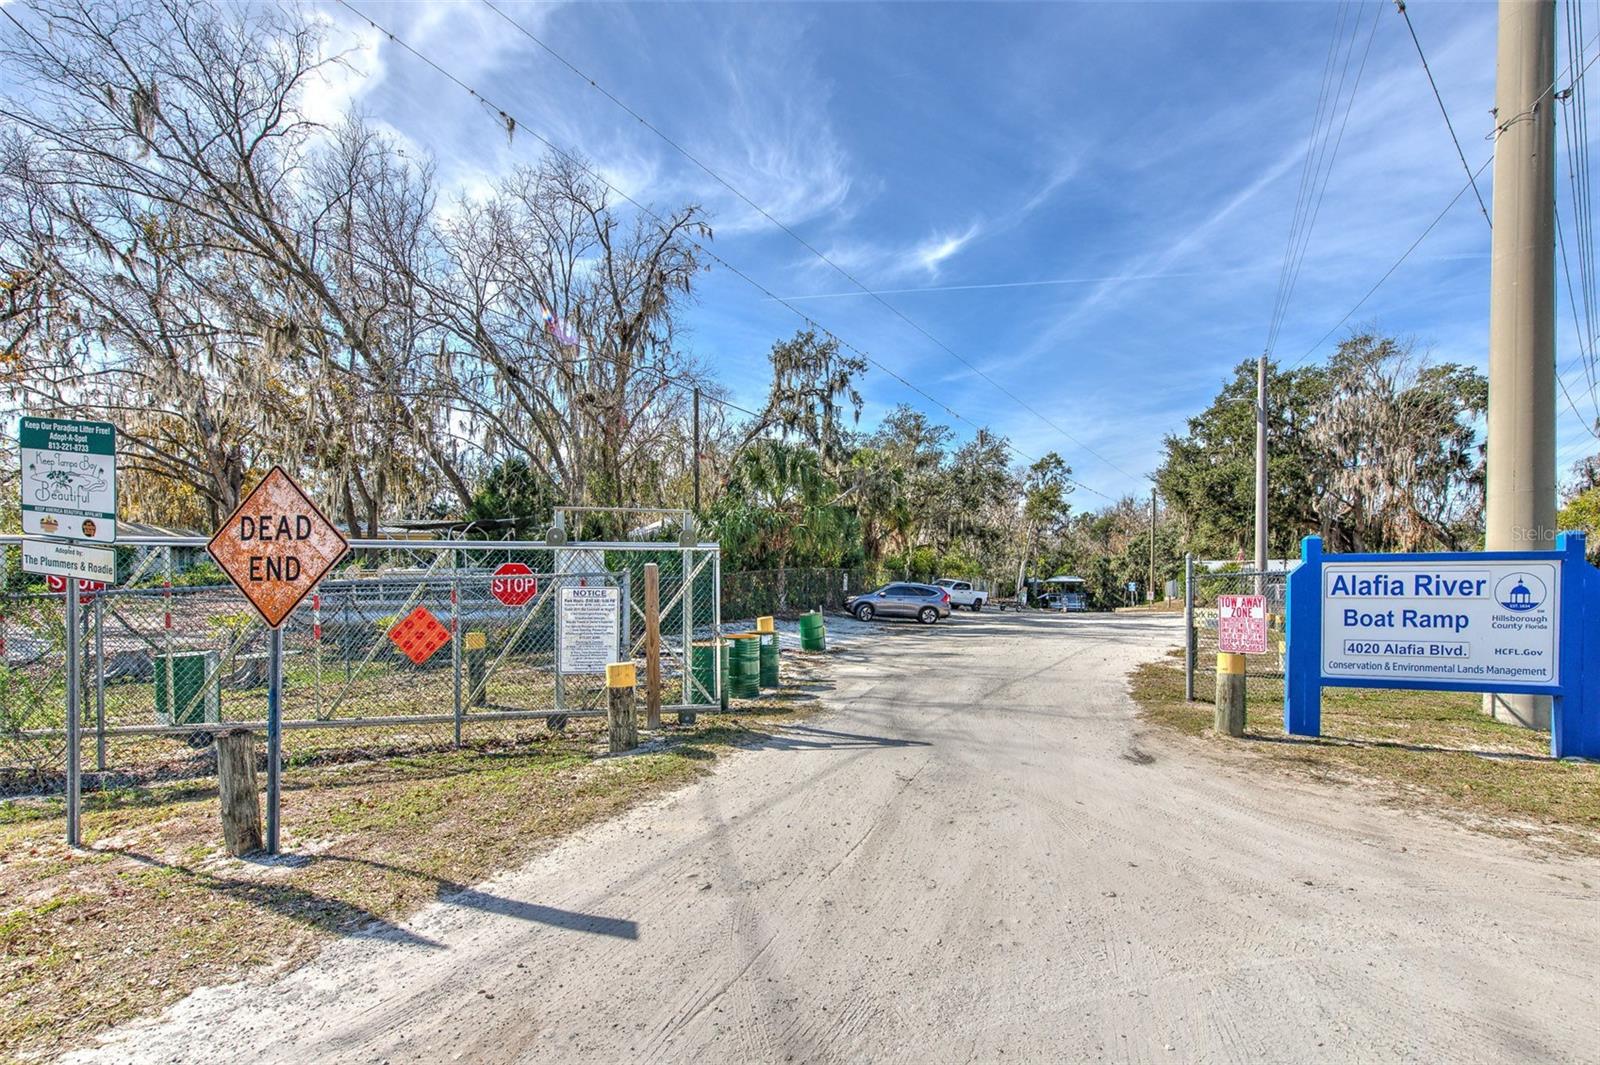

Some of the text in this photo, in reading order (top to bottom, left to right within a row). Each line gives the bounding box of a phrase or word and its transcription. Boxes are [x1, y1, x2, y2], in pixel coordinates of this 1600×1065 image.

[24, 421, 110, 435] Keep Our Paradise Litter Free!
[49, 432, 88, 443] Adopt-A-Spot
[48, 442, 89, 452] 813-221-8733
[36, 451, 97, 476] Keep Tampa Bay
[35, 481, 89, 509] Beautiful
[241, 514, 312, 541] DEAD
[55, 547, 75, 555] Adopted
[24, 554, 113, 575] The Plummers & Roadie
[250, 556, 301, 581] END
[494, 577, 534, 593] STOP
[1331, 574, 1487, 596] Alafia River
[573, 589, 607, 597] NOTICE
[1221, 597, 1264, 608] TOW AWAY
[1231, 607, 1253, 618] ZONE
[1343, 609, 1469, 633] Boat Ramp
[1492, 615, 1548, 624] Hillsborough
[1491, 622, 1523, 631] County
[1347, 643, 1467, 656] 4020 Alafia Blvd.
[1494, 648, 1543, 656] HCFL.Gov
[1328, 660, 1547, 676] Conservation & Environmental Lands Management
